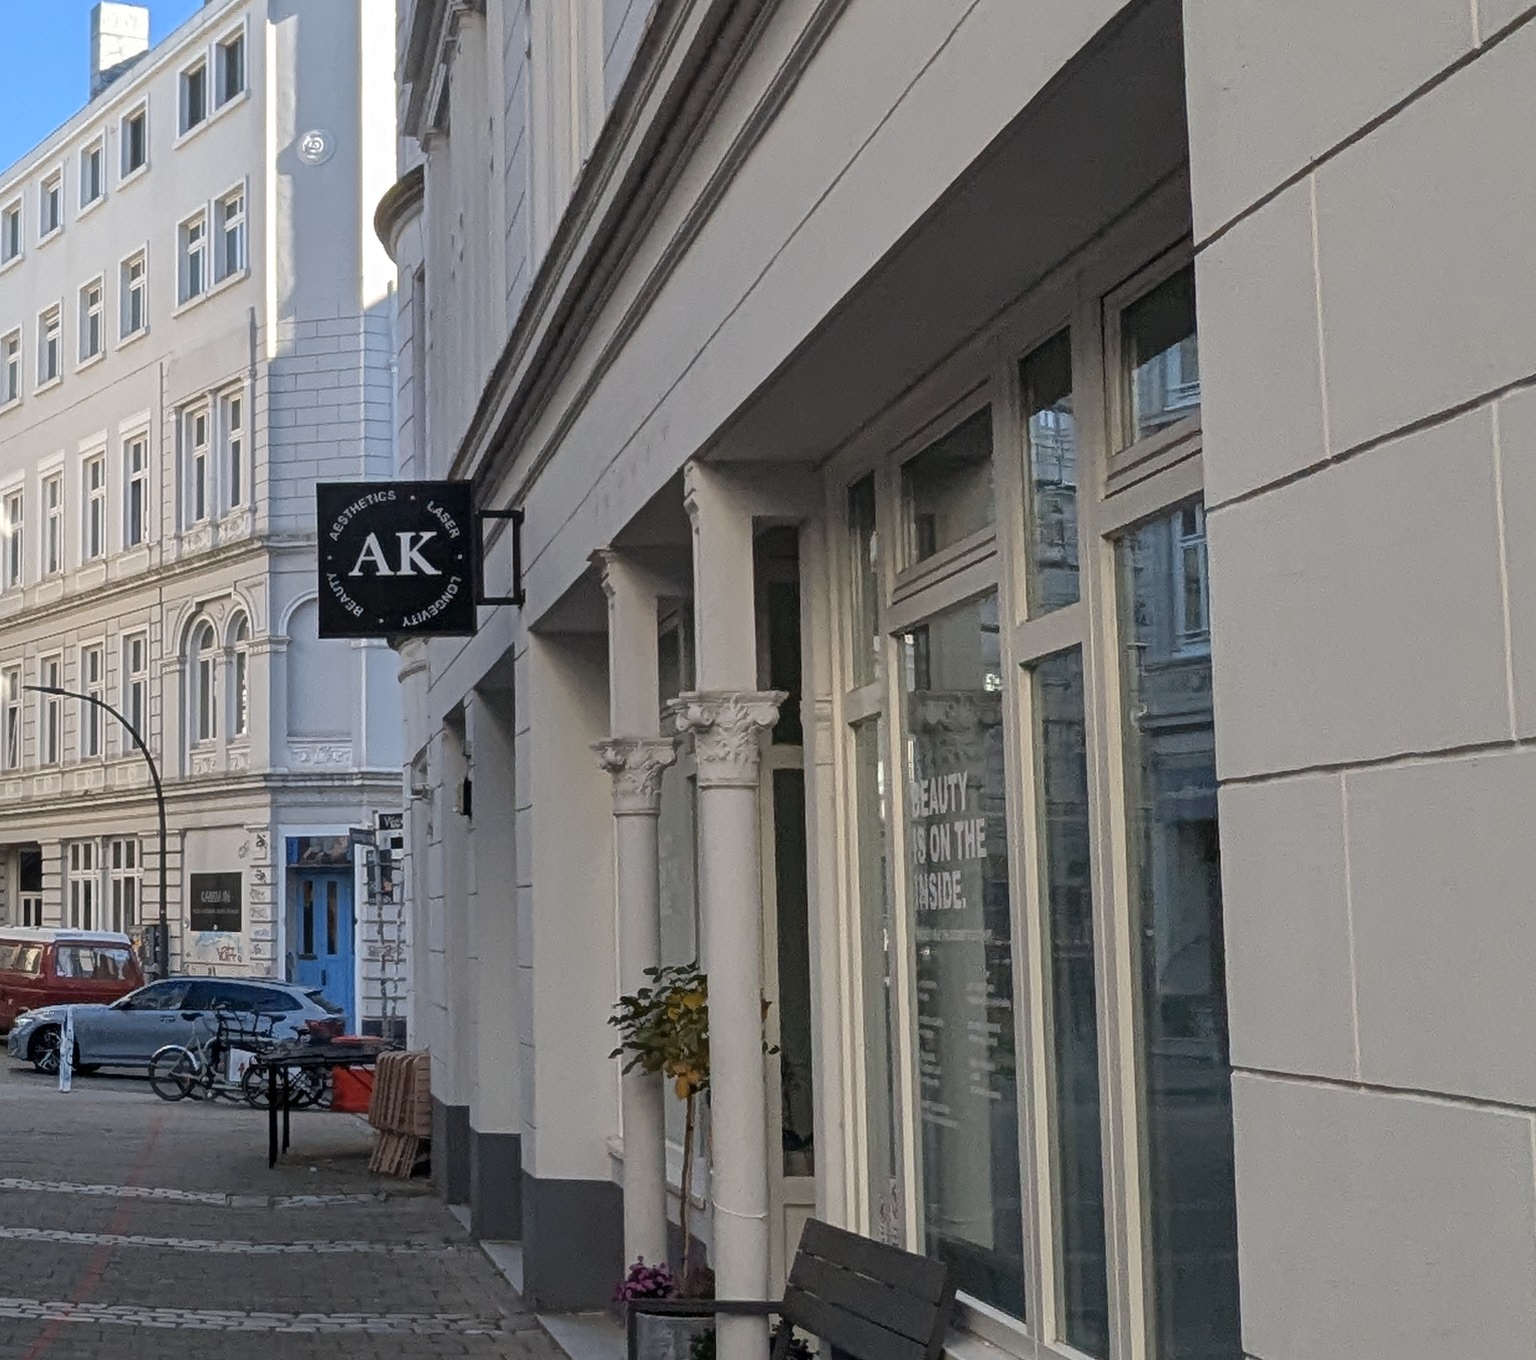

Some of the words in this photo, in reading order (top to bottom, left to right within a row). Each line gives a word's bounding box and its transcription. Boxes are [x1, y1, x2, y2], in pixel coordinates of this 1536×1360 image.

[328, 489, 397, 542] AESTHETICS
[425, 500, 461, 539] LASER
[348, 531, 443, 577] AK
[325, 571, 364, 618] BEAUTY
[402, 576, 462, 628] LONGEVITY
[912, 770, 967, 819] BEAUTY
[930, 823, 952, 863] ON
[954, 817, 987, 861] THE
